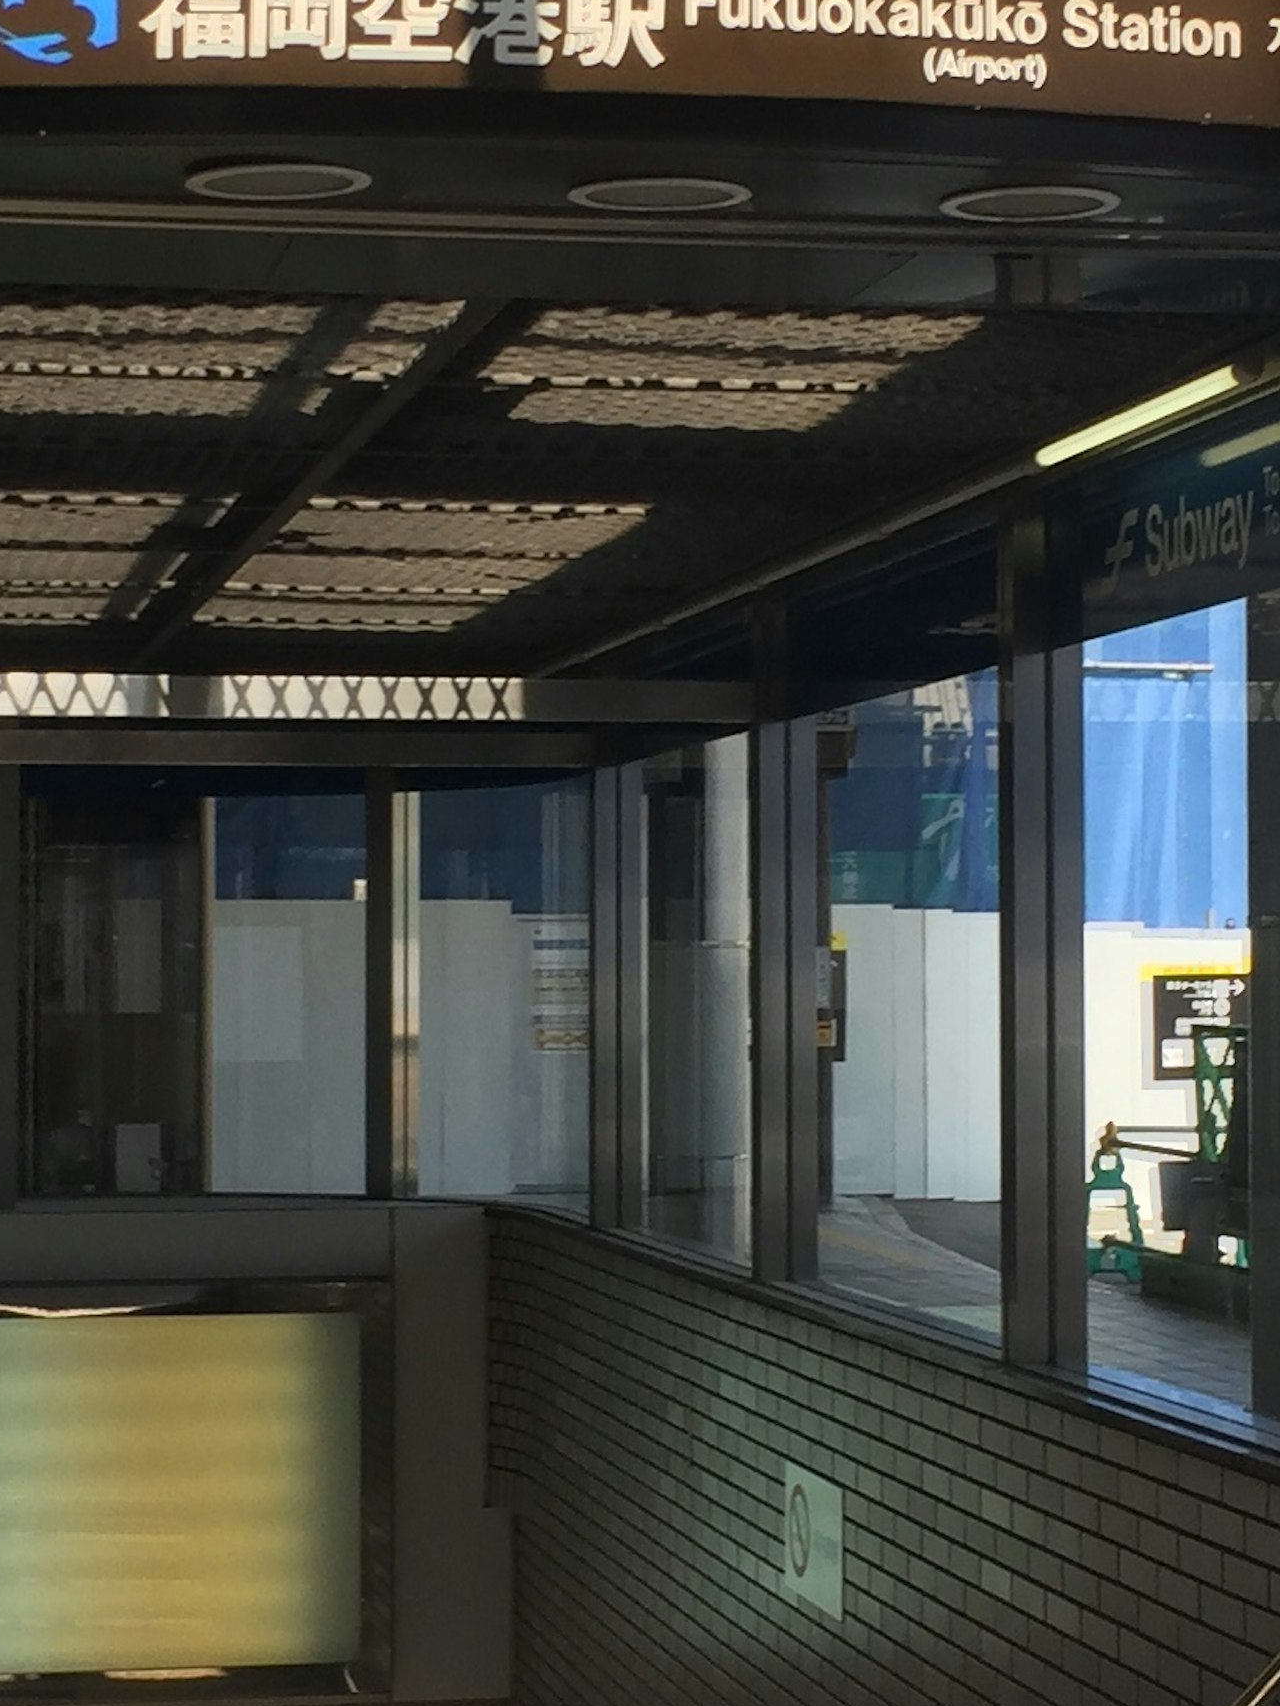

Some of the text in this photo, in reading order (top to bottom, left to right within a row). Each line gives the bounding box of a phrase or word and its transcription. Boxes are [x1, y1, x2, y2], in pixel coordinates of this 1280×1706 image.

[923, 46, 1048, 89] (Airport)
[1262, 464, 1280, 499] To
[1144, 489, 1255, 578] Subway
[1262, 503, 1280, 537] To
